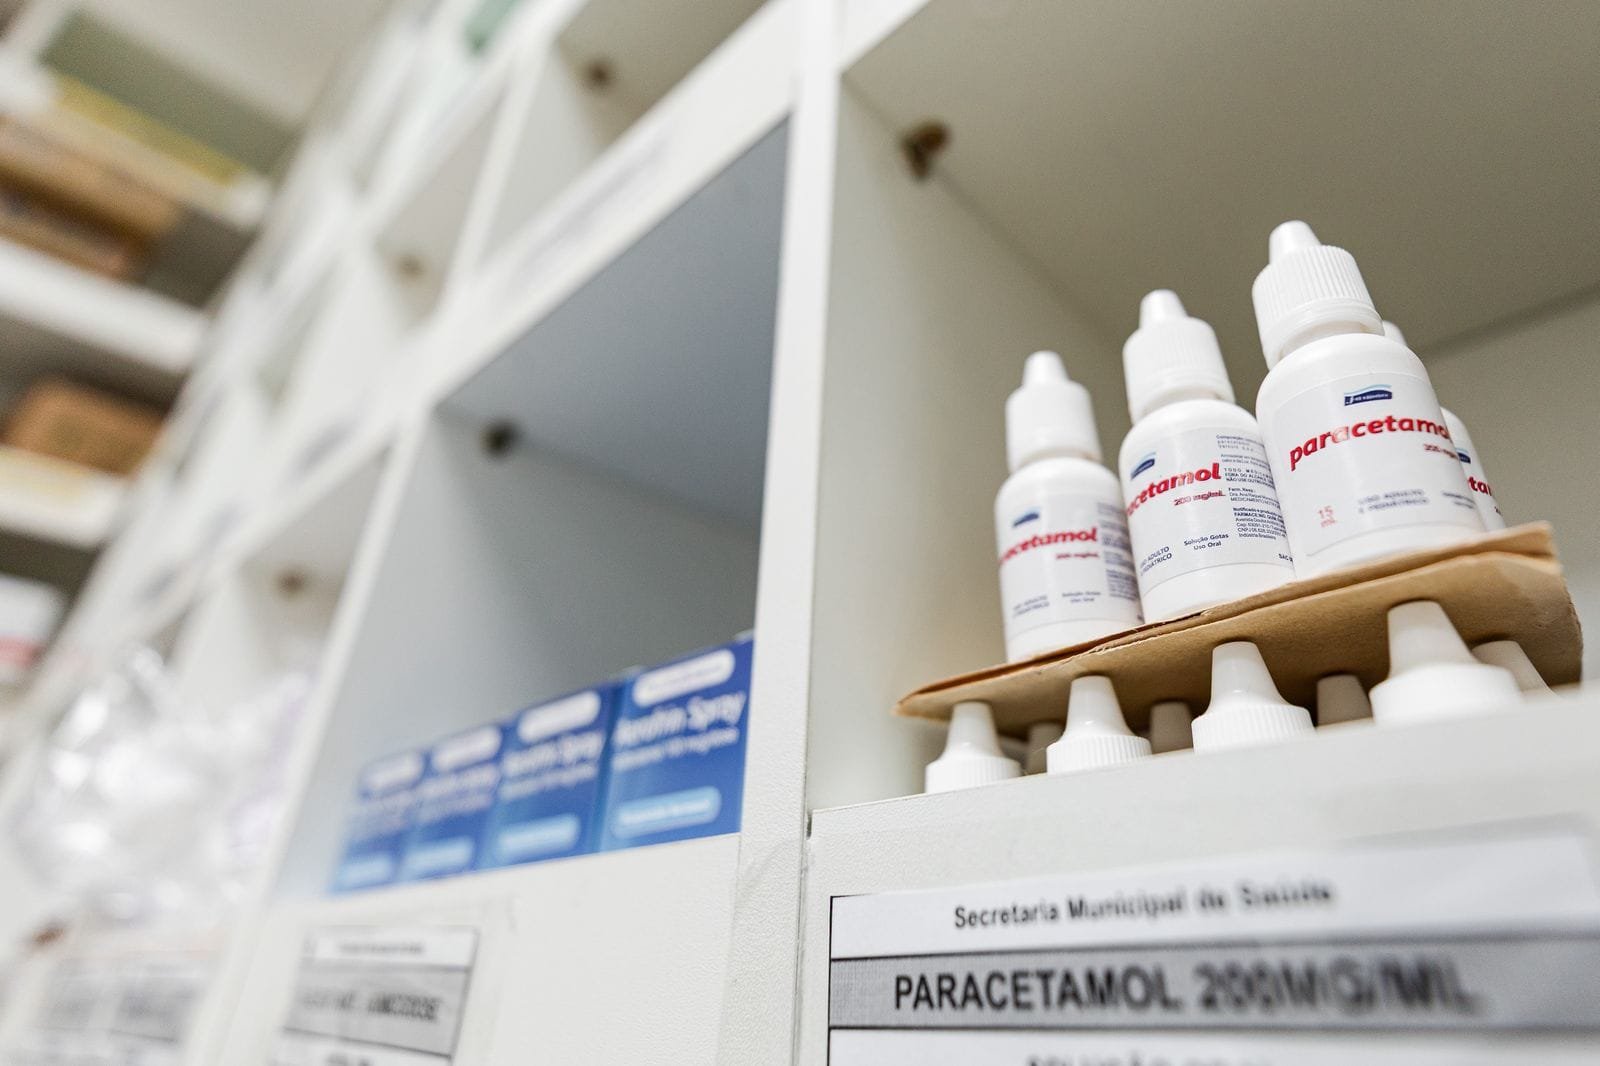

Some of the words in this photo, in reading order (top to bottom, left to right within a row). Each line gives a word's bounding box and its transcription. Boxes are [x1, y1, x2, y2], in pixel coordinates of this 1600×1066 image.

[1289, 415, 1450, 471] paracetamo
[1148, 546, 1170, 561] ADULTO
[1184, 535, 1209, 546] Solução
[1209, 532, 1229, 541] Gotas
[1193, 543, 1206, 551] Uso
[1207, 540, 1222, 548] Oral
[954, 896, 1059, 930] Secretaria
[1068, 885, 1186, 922] Municipal
[893, 966, 1182, 1012] PARACETAMOL
